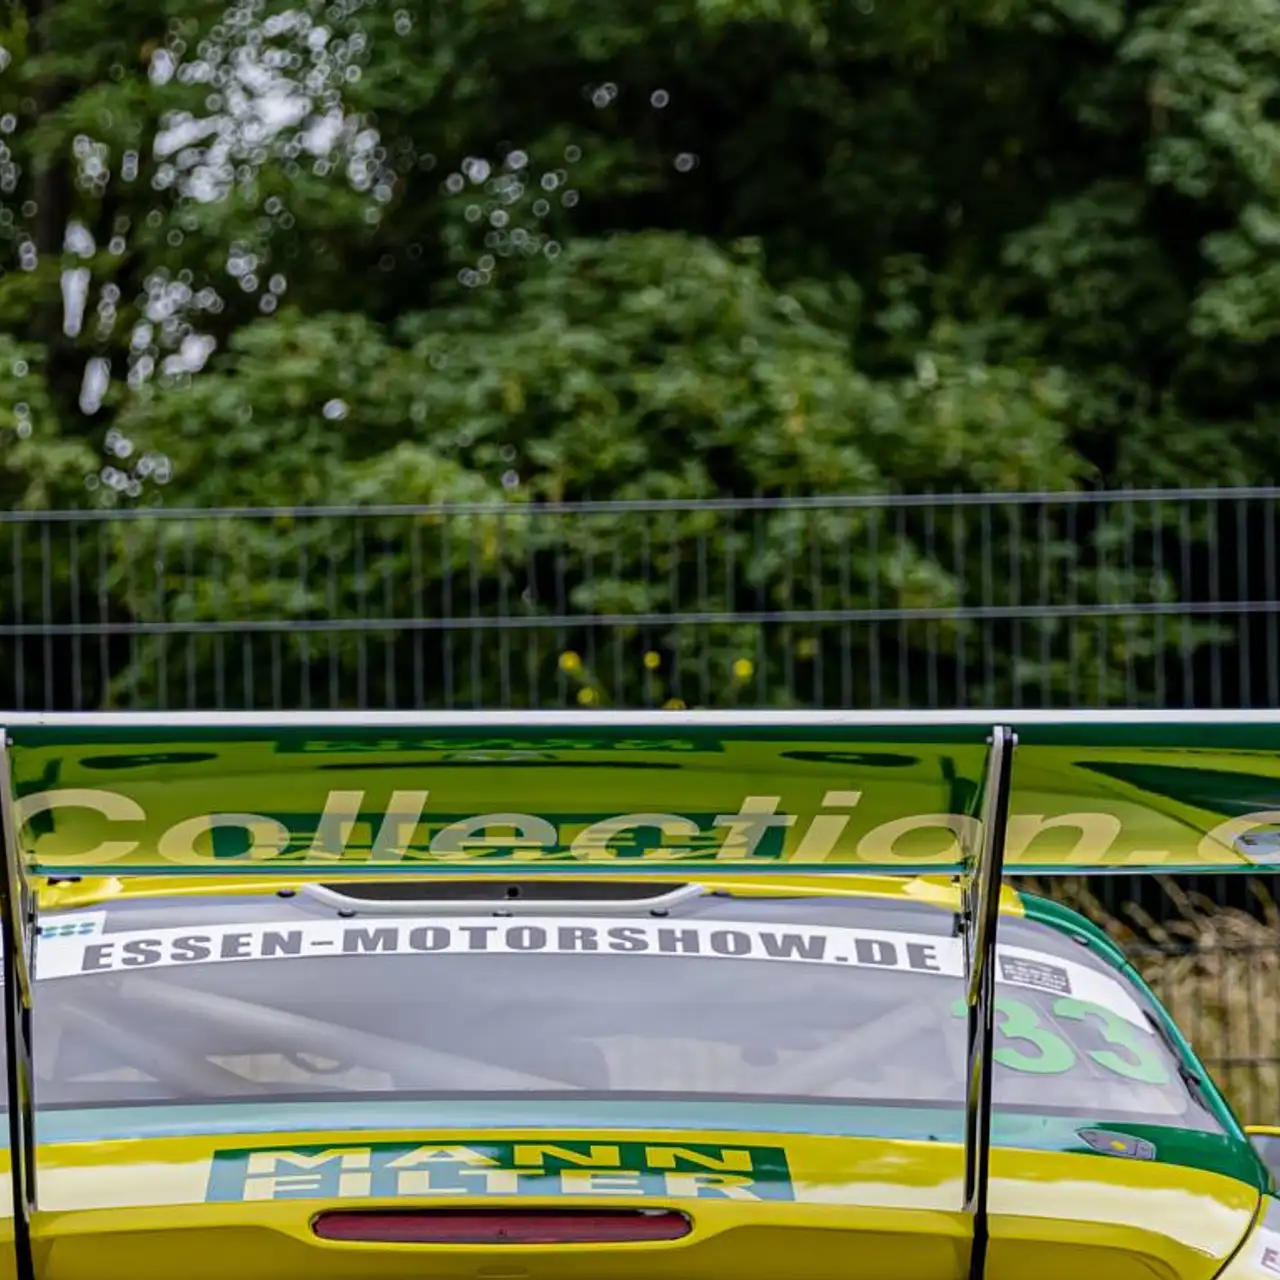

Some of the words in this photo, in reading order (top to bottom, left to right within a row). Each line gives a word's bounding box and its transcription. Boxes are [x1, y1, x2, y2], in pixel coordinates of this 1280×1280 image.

[81, 923, 941, 972] ESSEN-MOTORSHOW.DE
[950, 999, 1171, 1084] 33
[245, 1145, 753, 1172] MANN
[242, 1170, 762, 1201] FILTER
